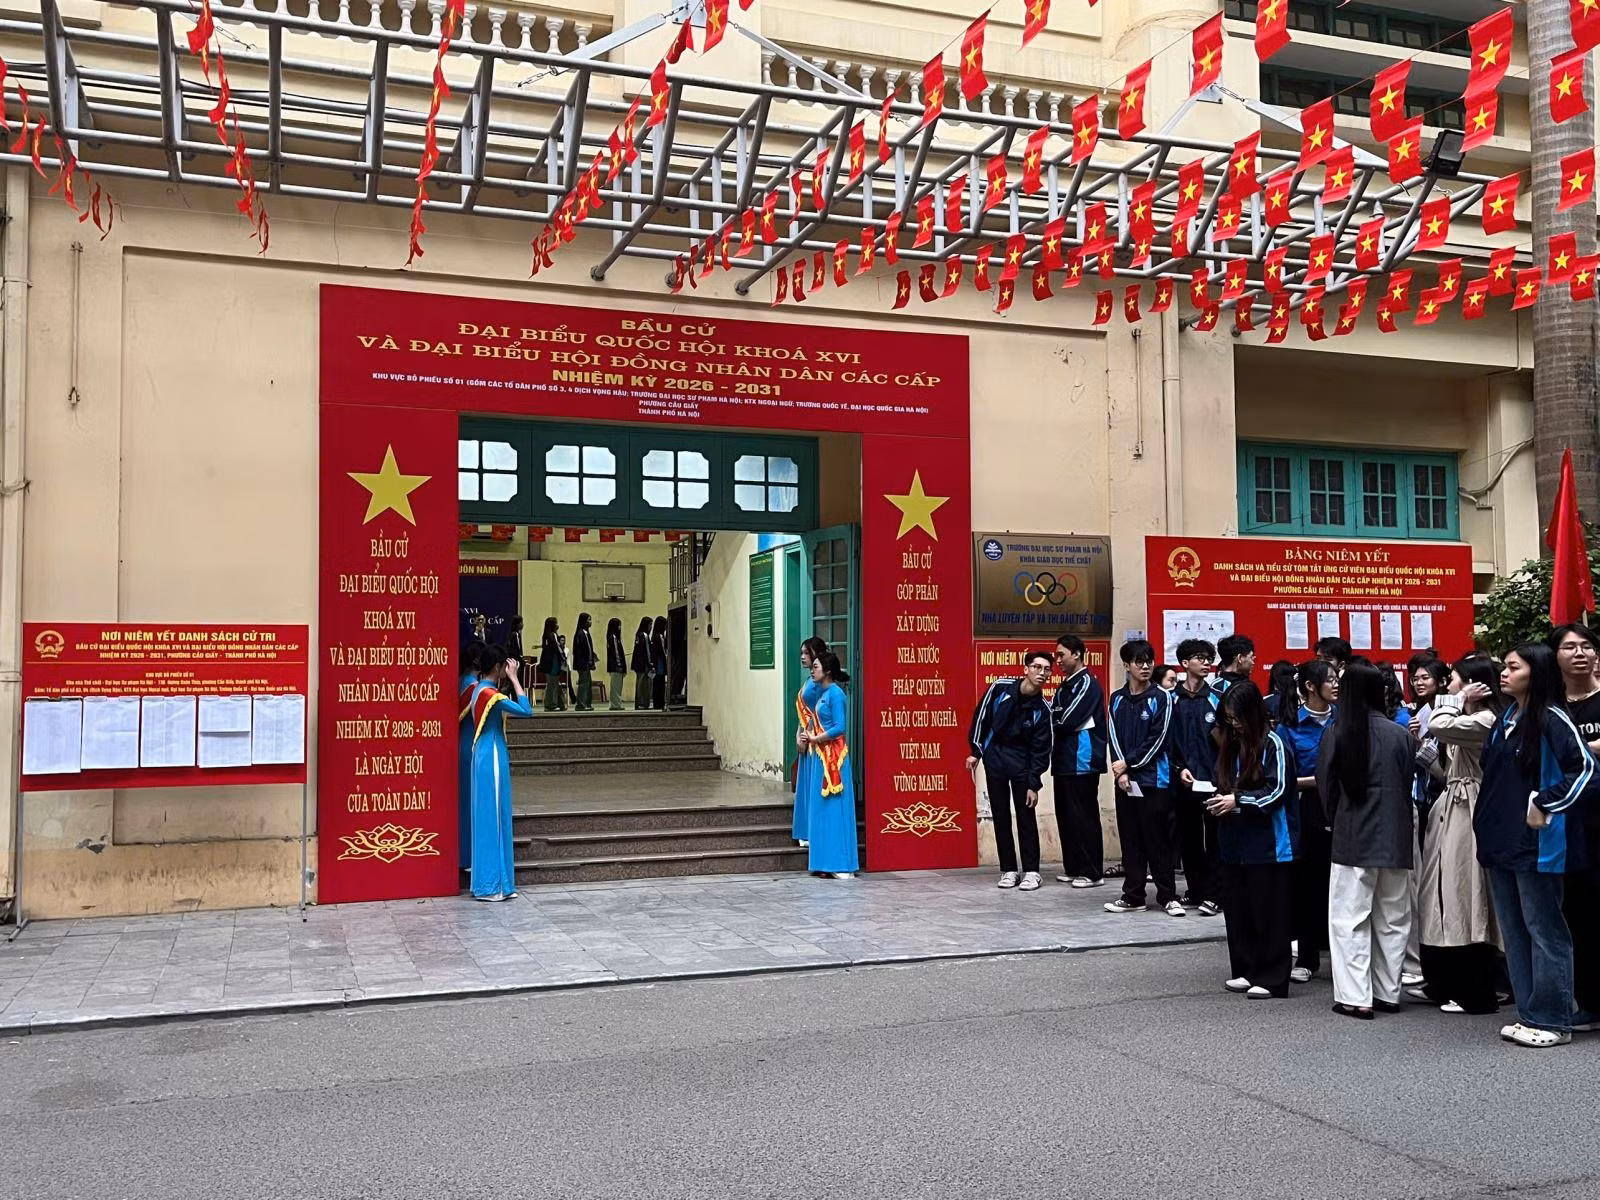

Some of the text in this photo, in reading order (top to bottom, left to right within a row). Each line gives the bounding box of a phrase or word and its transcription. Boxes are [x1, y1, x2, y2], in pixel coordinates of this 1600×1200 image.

[621, 318, 716, 336] BẦU CỬ
[458, 323, 861, 364] ĐẠI BIỂU QUỐC HỘI KHOÁ XVI
[357, 334, 941, 387] VÀ ĐẠI BIỂU HỘI ĐỒNG NHÂN DÂN CÁC CẤP
[419, 375, 442, 383] PHIẾU
[443, 376, 454, 384] SỐ
[488, 379, 503, 387] CÁC
[592, 388, 611, 396] VỌNG
[552, 369, 781, 396] NHIỆM KỲ 2026 2031
[371, 528, 409, 558] BẦU CỬ
[1285, 546, 1390, 562] BẢNG NIÊM YẾT
[902, 544, 932, 569] BẦU CỬ
[1213, 562, 1233, 570] DANH
[1234, 562, 1254, 571] SÁCH
[1255, 563, 1265, 571] VÀ
[1395, 566, 1412, 575] QUỐC
[340, 562, 439, 598] ĐẠI BIỂU QUỐC HỘI
[896, 576, 938, 600] GÓP PHẦN
[1230, 573, 1240, 582] VÀ
[1272, 574, 1284, 584] HỘI
[1342, 576, 1356, 584] CÁC
[1357, 576, 1370, 584] CẤP
[364, 605, 416, 629] KHOÁ XVI
[896, 610, 940, 636] XÂY DỰNG
[101, 629, 276, 641] NƠI NIÊM YẾT DANH SÁCH CỬ TRI
[330, 635, 448, 670] VÀ ĐẠI BIỂU HỘI ĐỒNG
[897, 642, 940, 663] NHÀ NƯỚC
[981, 648, 1103, 666] NƠI NIÊM YẾ TRI
[339, 674, 440, 702] NHÂN DÂN CÁC CẤP
[892, 670, 945, 696] PHÁP QUYỀN
[336, 714, 442, 744] NHIỆM KỲ 2026 2031
[880, 703, 958, 731] XÃ HỘI CHỦ NGHĨA
[900, 737, 940, 764] VIỆT NAM
[355, 749, 423, 779] LÀ NGÀY HỘI
[894, 770, 917, 792] VỮNG
[347, 784, 369, 813] CỦA
[372, 787, 400, 811] TOÀN
